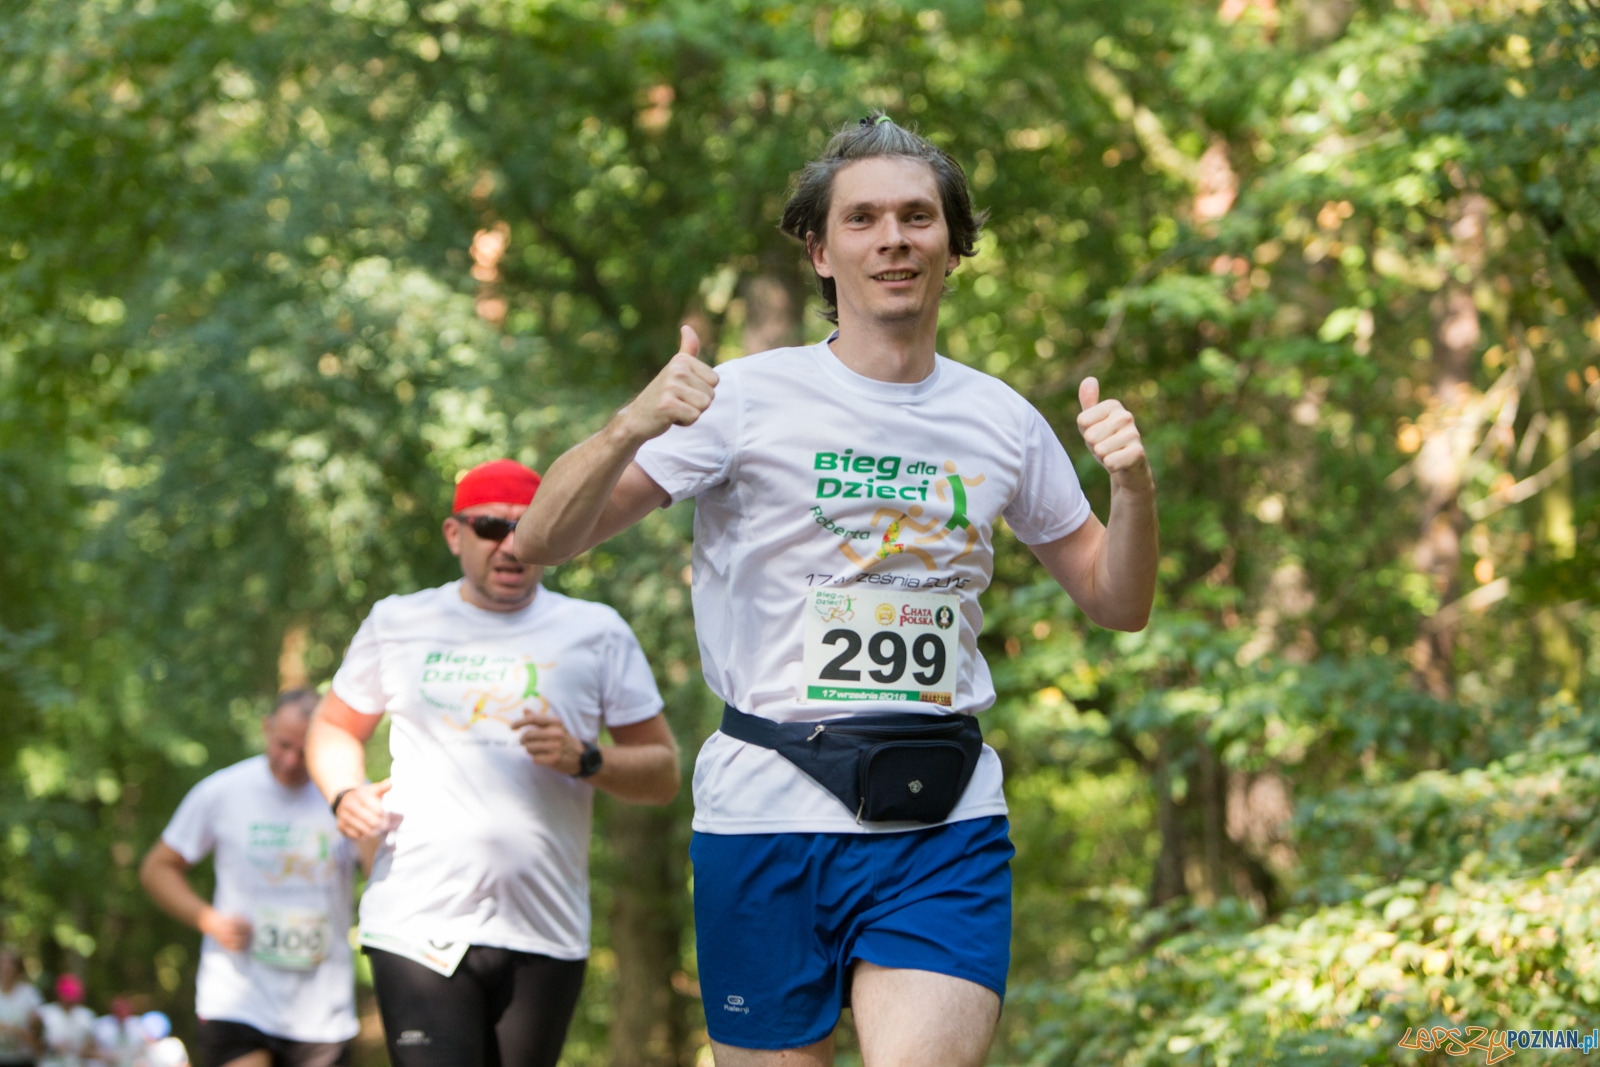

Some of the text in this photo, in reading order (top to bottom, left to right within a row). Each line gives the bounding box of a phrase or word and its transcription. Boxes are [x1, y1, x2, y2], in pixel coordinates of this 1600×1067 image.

[814, 448, 938, 480] Bieg dla
[815, 478, 929, 501] Dzieci
[810, 505, 870, 540] Roberta
[805, 573, 833, 587] 17
[815, 598, 842, 606] Dzieci
[816, 591, 836, 600] Bieg
[901, 604, 933, 617] CHATA
[899, 615, 934, 627] POLSKA
[424, 650, 487, 666] Bieg
[818, 628, 946, 686] 299
[421, 666, 507, 682] Dzieci
[822, 689, 837, 698] 17
